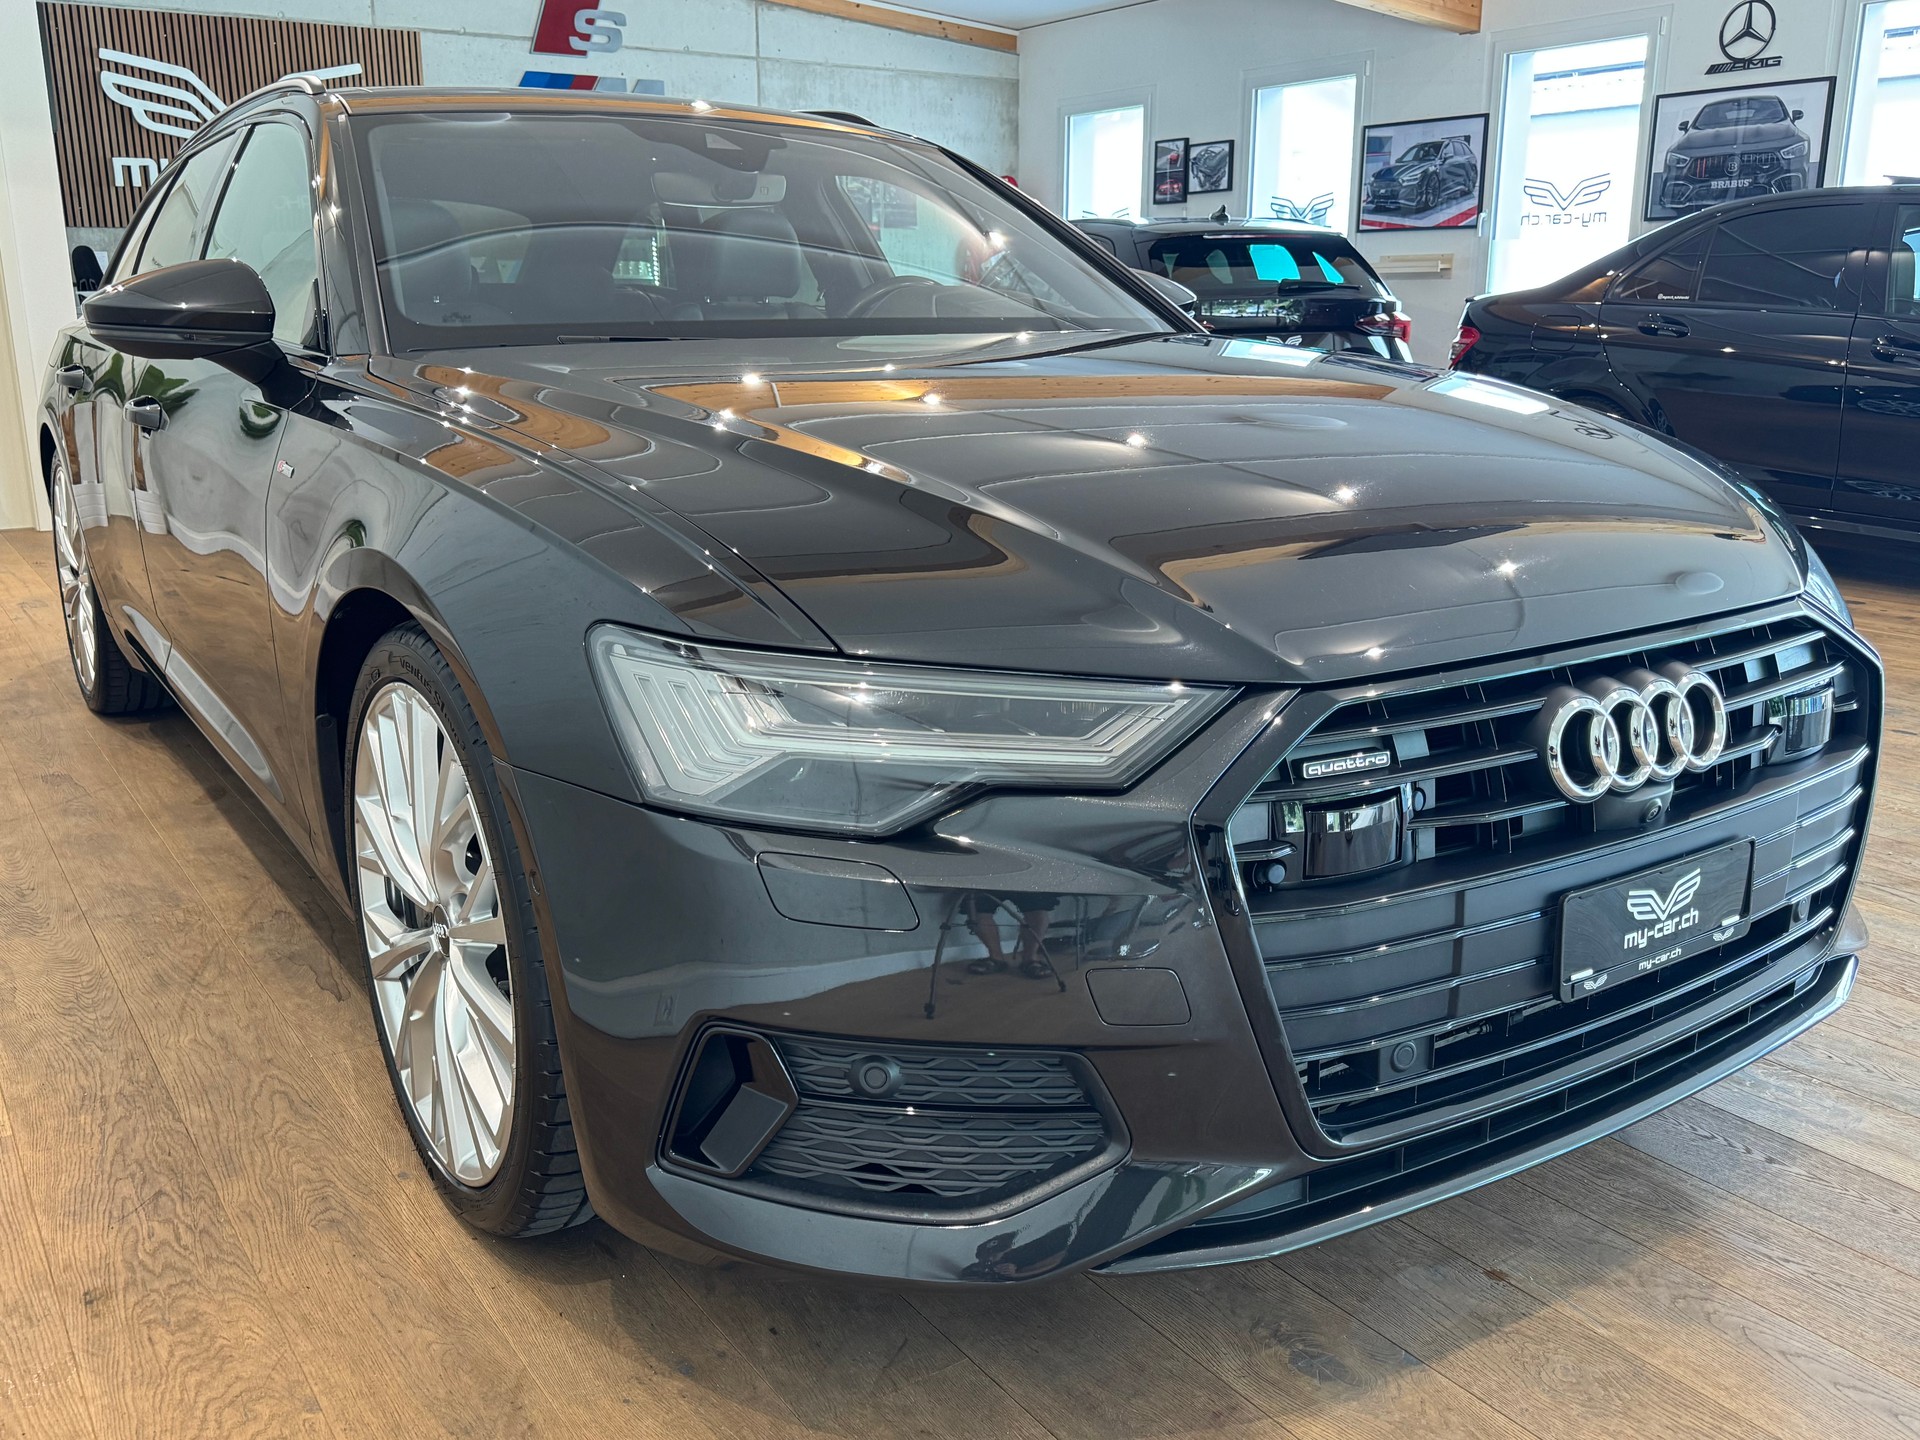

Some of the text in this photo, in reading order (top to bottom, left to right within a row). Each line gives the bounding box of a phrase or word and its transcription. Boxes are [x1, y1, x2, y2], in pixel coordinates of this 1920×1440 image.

[1308, 754, 1388, 776] quattro
[1623, 907, 1699, 949] my-car.ch
[1638, 947, 1682, 970] my-car.ch
